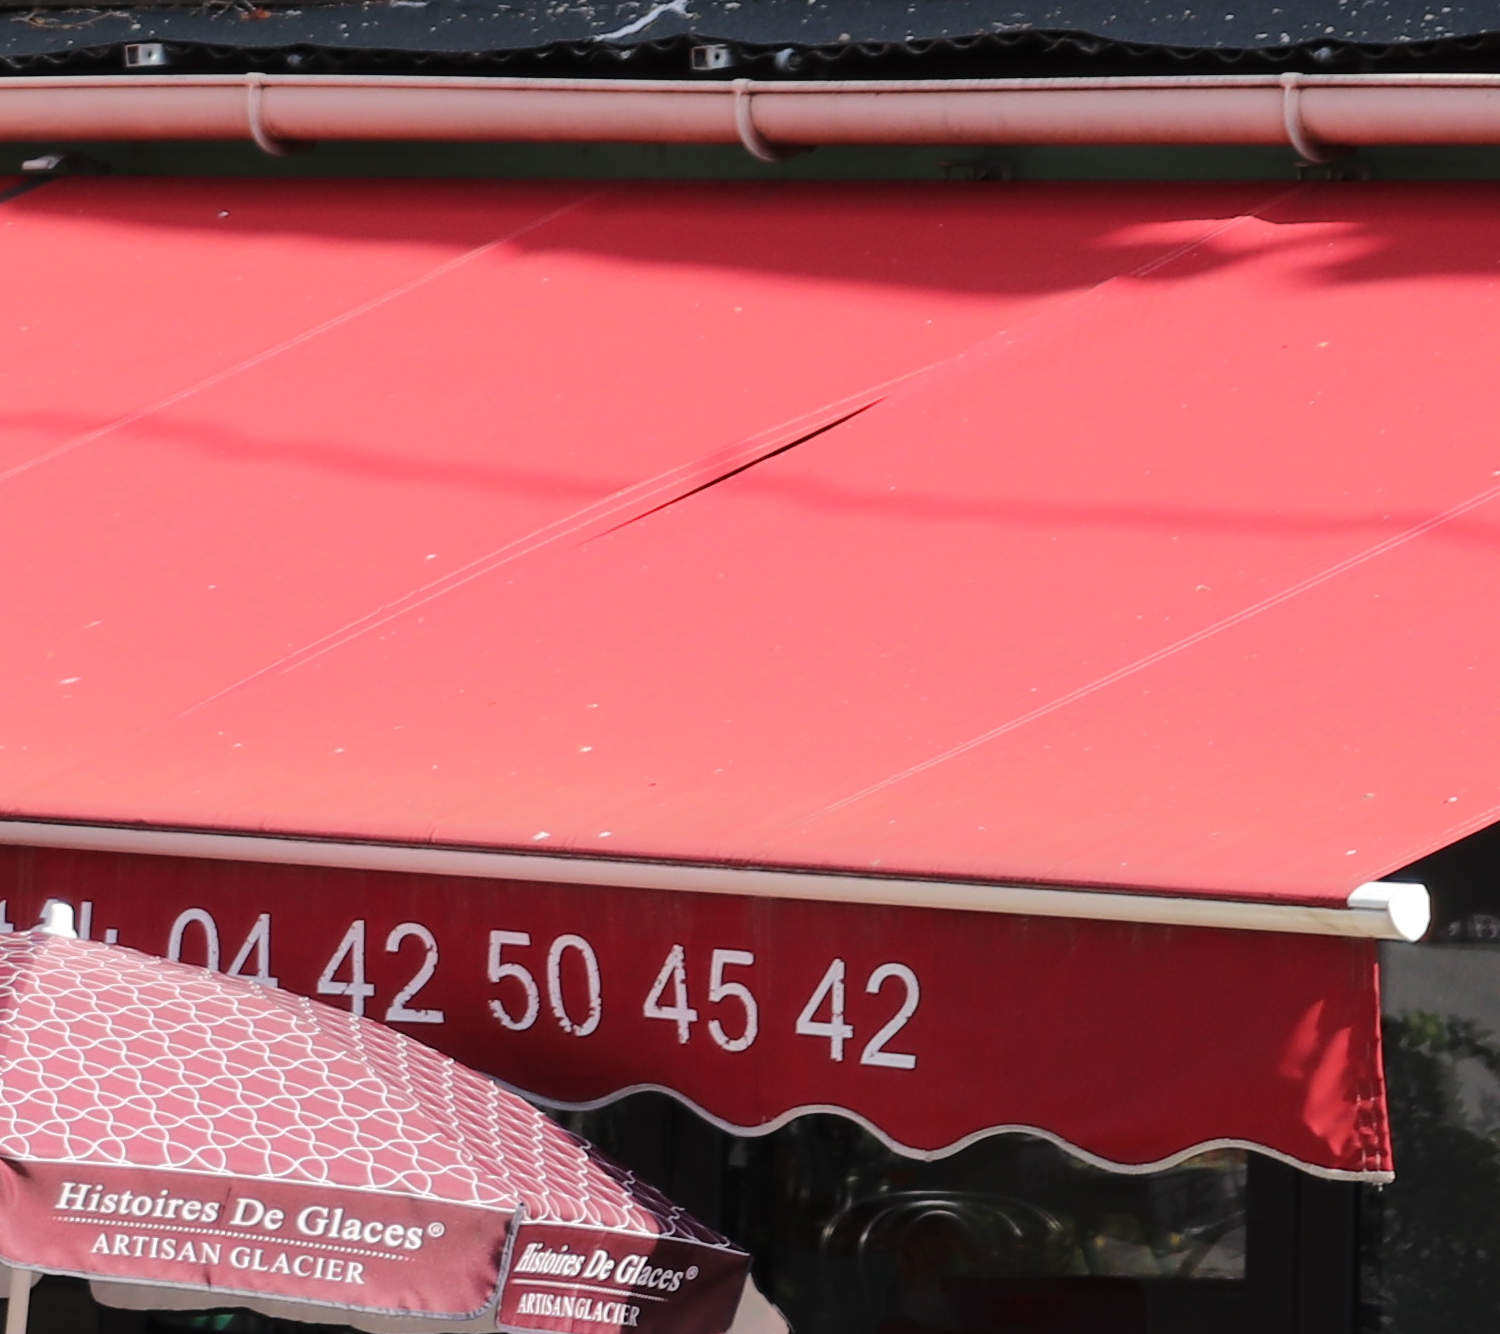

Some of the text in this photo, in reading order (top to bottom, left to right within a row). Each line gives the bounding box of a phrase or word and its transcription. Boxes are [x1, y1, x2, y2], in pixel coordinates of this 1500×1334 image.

[167, 908, 279, 989] 04
[317, 919, 445, 1024] 42
[487, 932, 603, 1037] 50
[644, 945, 759, 1054] 45
[796, 958, 920, 1069] 42
[55, 1181, 221, 1223] Histoires
[230, 1197, 285, 1230] De
[91, 1232, 366, 1285] ARTISAN GLACIER
[514, 1243, 585, 1276] Histoires
[582, 1249, 615, 1280] De
[517, 1293, 641, 1327] ARTISAN GLACIER
